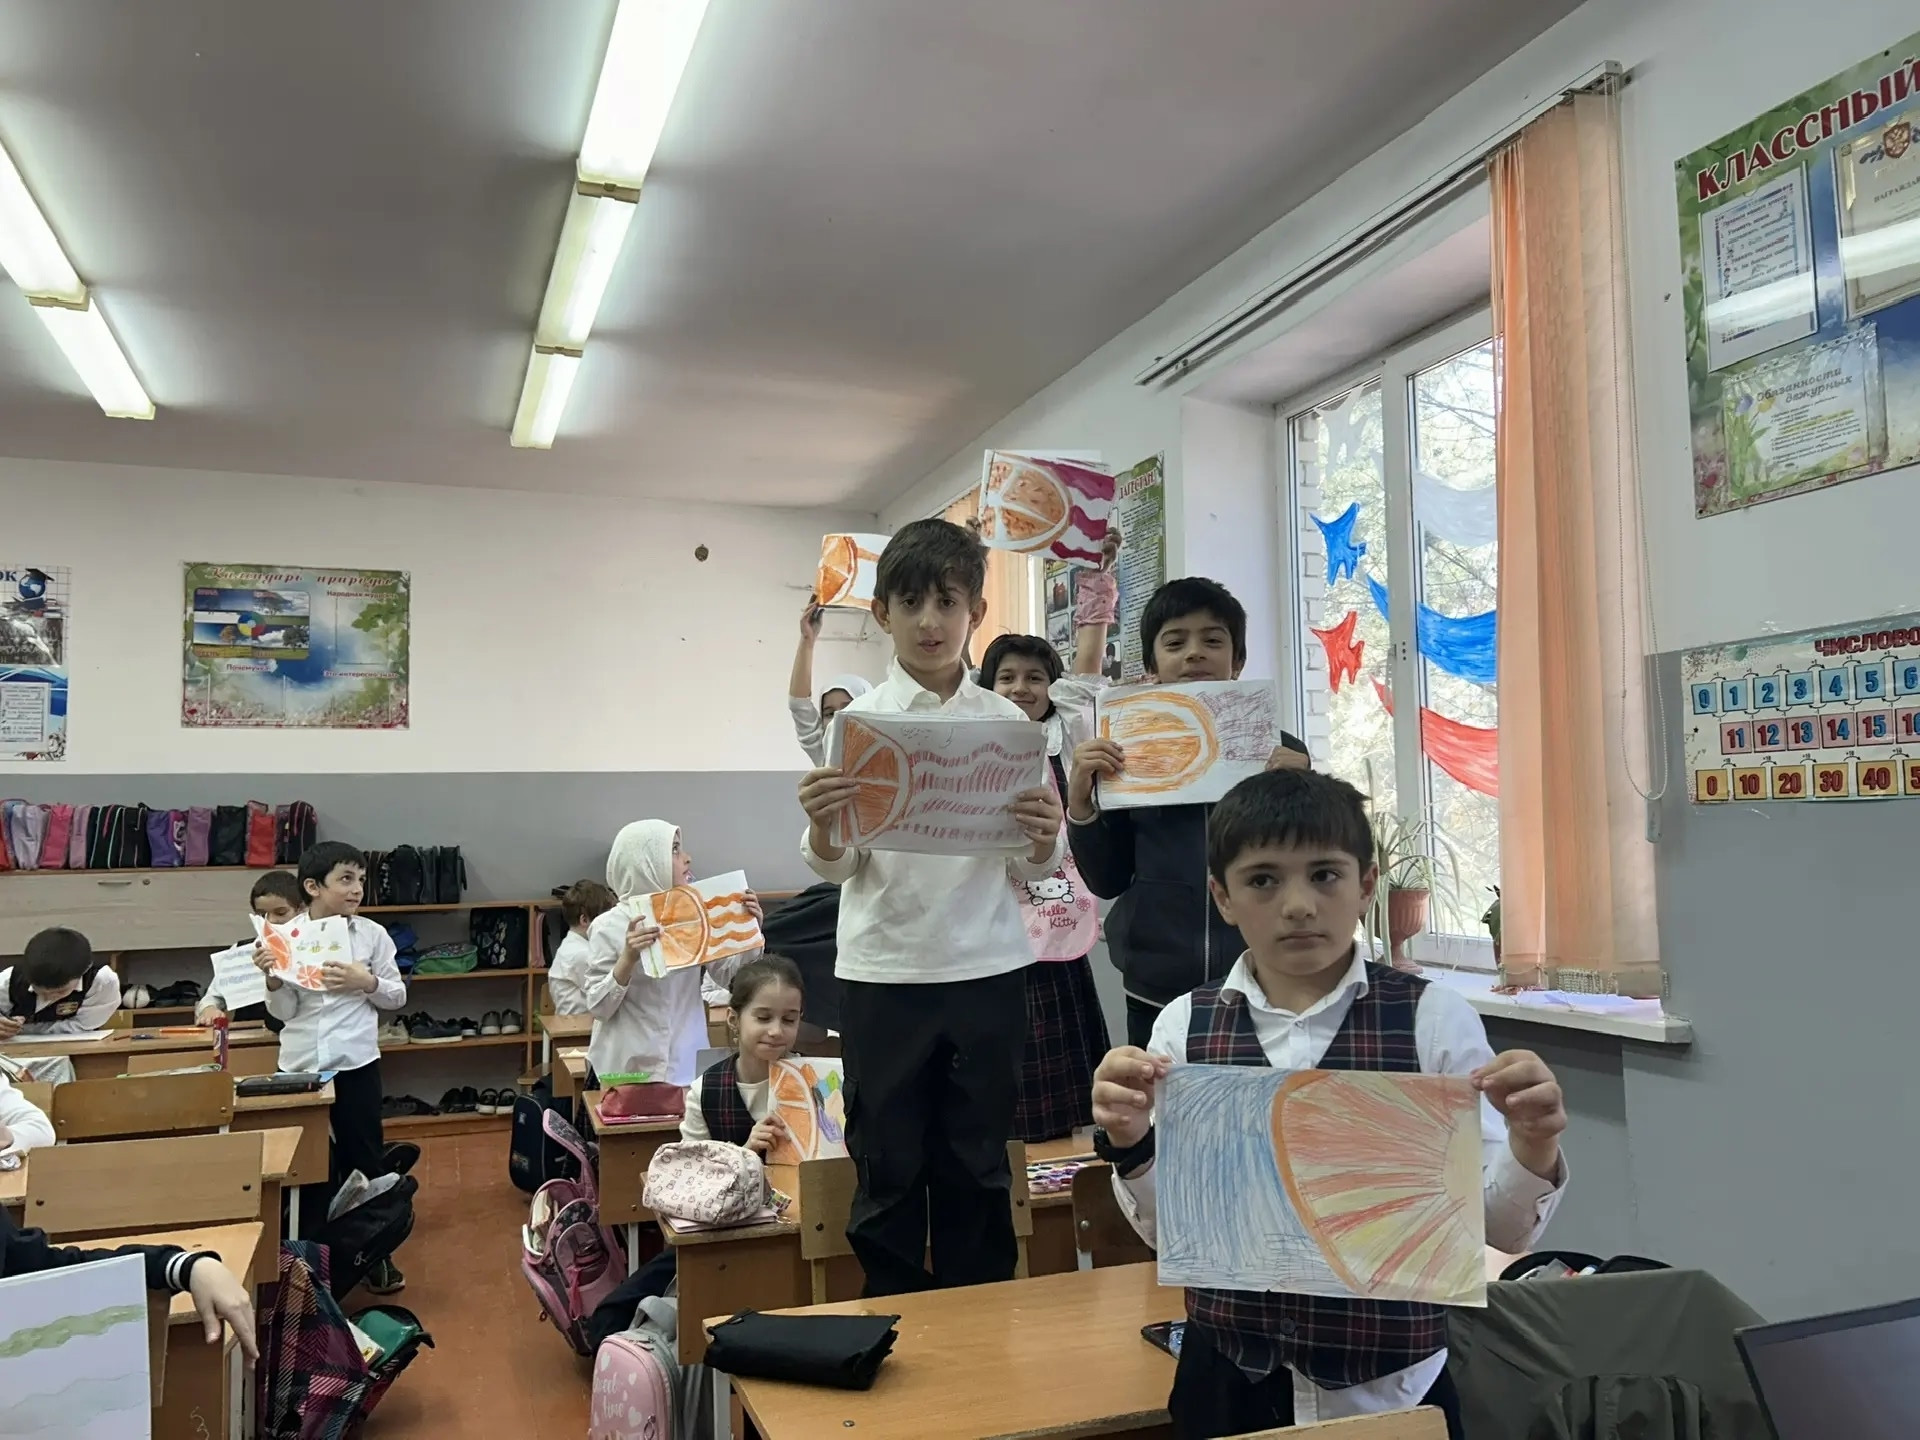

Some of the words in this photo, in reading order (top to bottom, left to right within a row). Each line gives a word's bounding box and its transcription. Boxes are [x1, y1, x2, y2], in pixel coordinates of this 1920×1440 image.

[1698, 57, 1920, 202] КЛАССНЫЙ
[1756, 368, 1842, 402] Обязанности
[1815, 627, 1920, 657] ЧИСЛОВО
[1699, 689, 1710, 709] 0
[1729, 686, 1738, 706] 1
[1762, 683, 1775, 703] 2
[1794, 679, 1807, 699] 3
[1829, 675, 1843, 696] 4
[1865, 670, 1879, 693] 5
[1904, 667, 1918, 689] 6
[1727, 728, 1745, 748] 11
[1757, 724, 1780, 746] 12
[1791, 721, 1813, 744] 13
[1827, 718, 1850, 741] 14
[1862, 714, 1887, 738] 15
[1707, 776, 1718, 796] 0
[1739, 774, 1760, 795] 10
[1778, 772, 1802, 794] 20
[1819, 770, 1844, 792] 30
[1862, 767, 1891, 790] 40
[1037, 904, 1067, 918] Hello
[1049, 917, 1078, 930] Kitty
